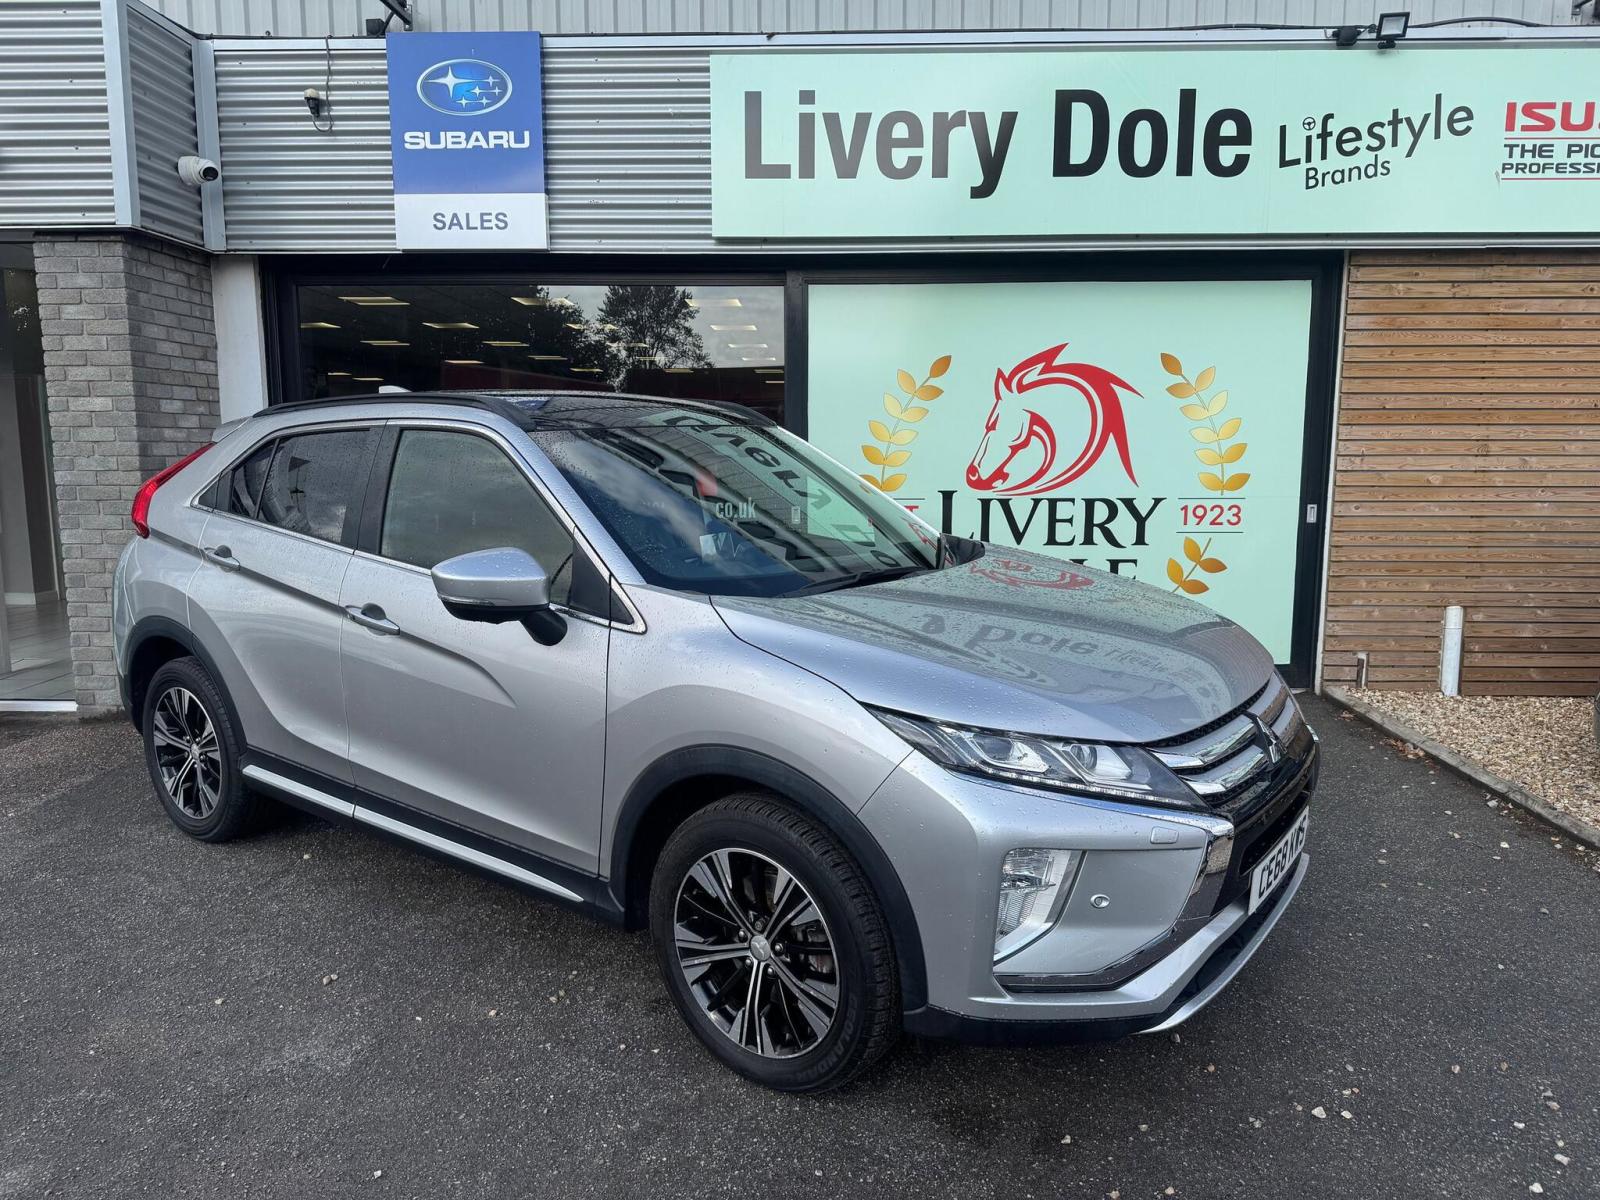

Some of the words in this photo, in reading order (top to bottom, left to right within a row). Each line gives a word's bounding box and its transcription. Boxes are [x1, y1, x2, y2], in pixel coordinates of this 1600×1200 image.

[1279, 93, 1474, 168] Lifestyle
[1505, 101, 1600, 132] ISU
[404, 130, 530, 149] SUBARU
[744, 89, 1019, 199] Livery
[1052, 88, 1253, 178] Dole
[1503, 144, 1554, 159] THE
[1305, 154, 1391, 190] Brands
[432, 212, 509, 231] SALES
[715, 496, 756, 519] co.uk
[937, 490, 1167, 549] LIVERY
[1179, 504, 1242, 526] 1923
[1258, 839, 1289, 899] CE68
